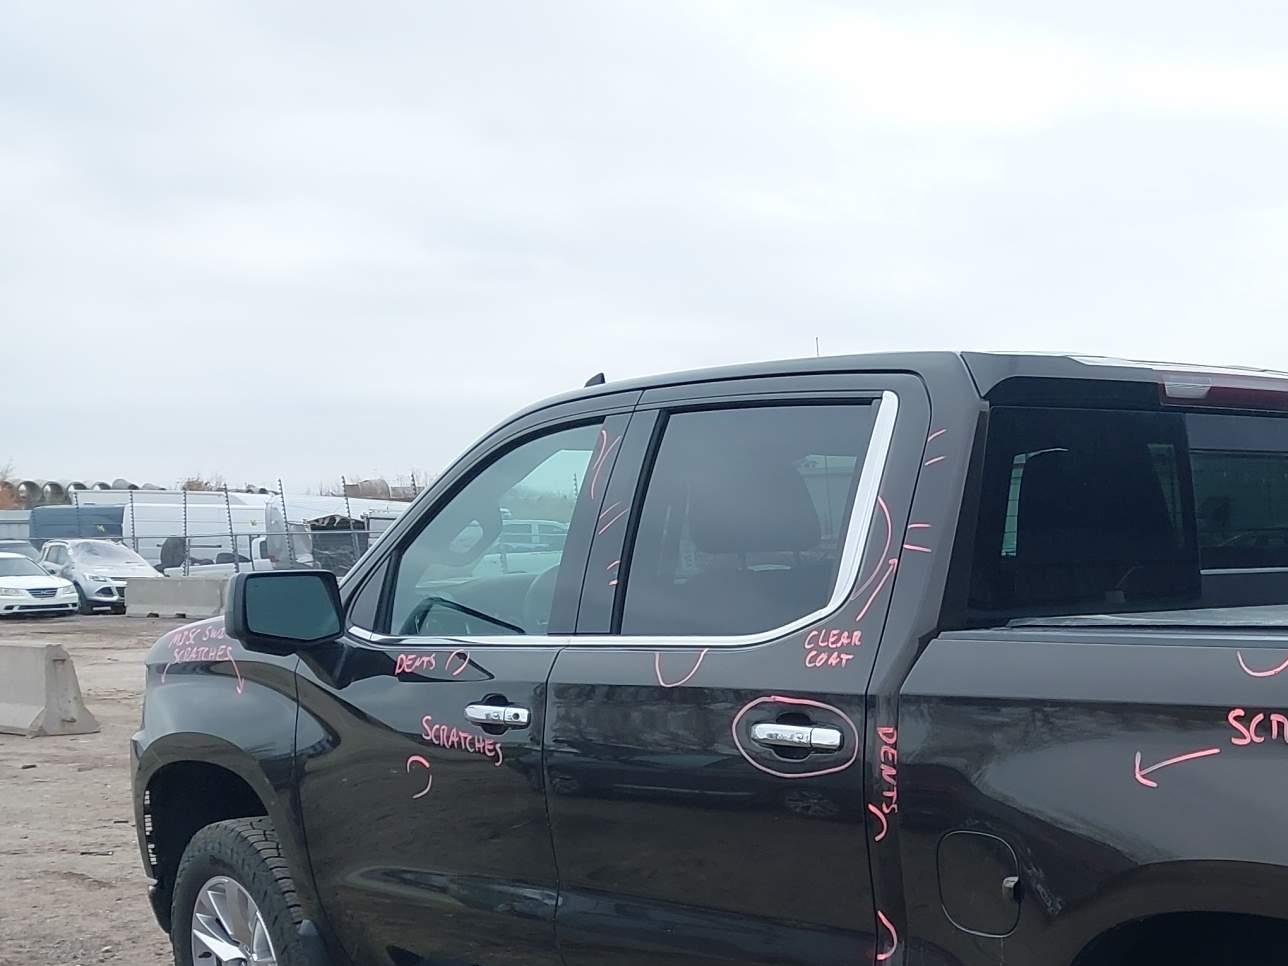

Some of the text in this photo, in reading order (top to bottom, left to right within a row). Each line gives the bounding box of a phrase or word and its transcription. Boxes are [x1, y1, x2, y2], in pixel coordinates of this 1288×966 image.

[804, 629, 862, 650] CLEAR
[174, 645, 232, 664] SCRATCHES
[395, 653, 436, 675] DENTS
[805, 653, 854, 668] COAT
[421, 715, 503, 767] SCRATCHES
[876, 726, 898, 814] DENTS
